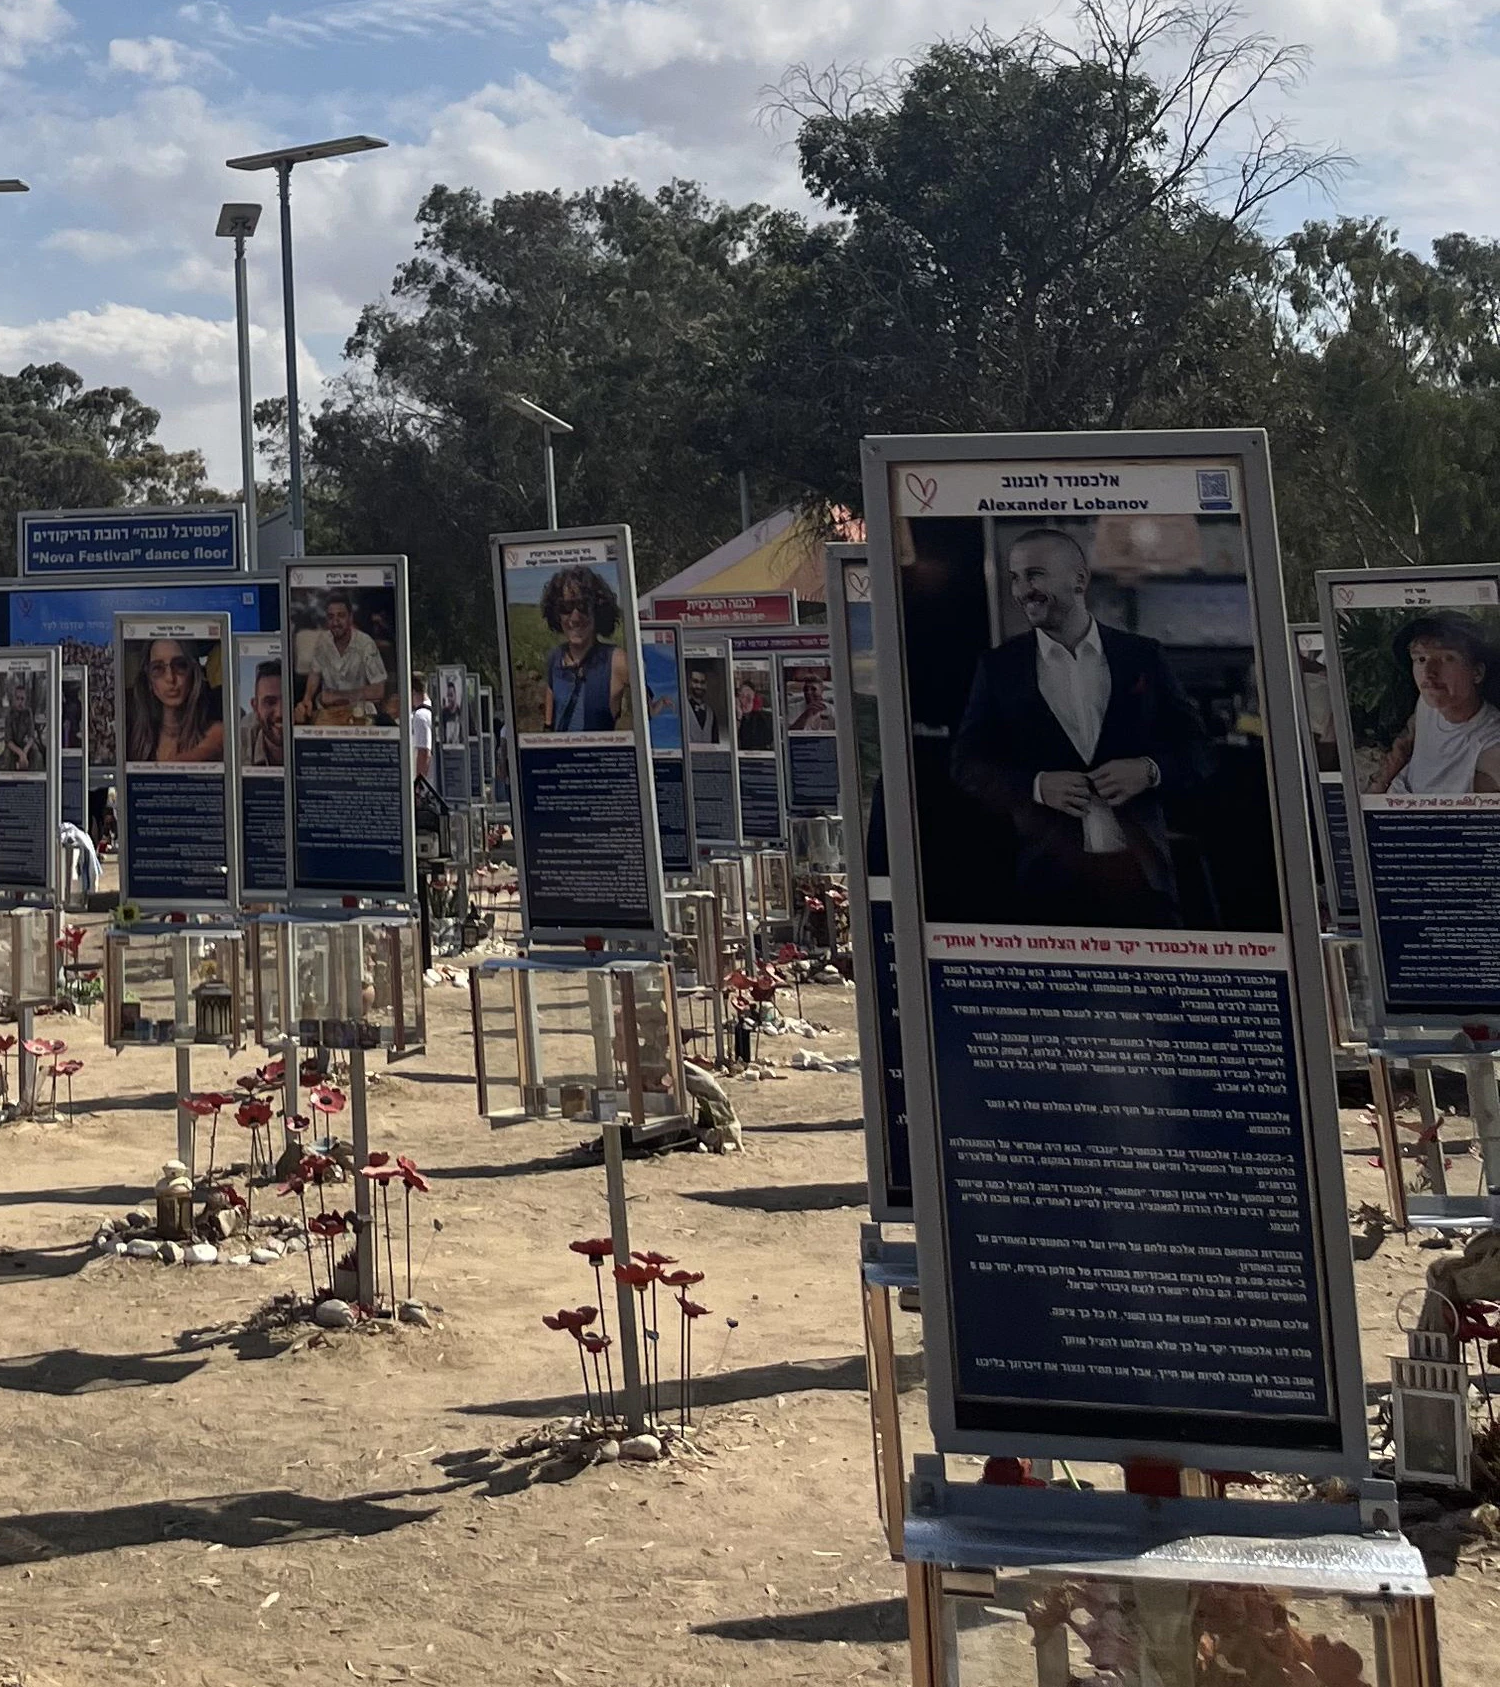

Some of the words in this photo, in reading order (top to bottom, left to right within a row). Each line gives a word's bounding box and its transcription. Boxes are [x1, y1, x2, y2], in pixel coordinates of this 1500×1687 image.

[1001, 473, 1049, 489] לובנוב
[1054, 473, 1121, 488] אלכסנדר
[977, 498, 1068, 512] Alexander
[1073, 497, 1150, 511] Lobanov
[33, 530, 91, 545] הריקודים
[94, 528, 130, 542] רחבת
[145, 547, 190, 561] dance
[193, 546, 229, 560] floor
[728, 597, 756, 610] הבמה
[679, 612, 701, 624] The
[703, 612, 730, 623] Main
[732, 611, 766, 623] Stage
[979, 934, 1022, 950] להציל
[1026, 937, 1076, 951] הצלחנו
[1080, 938, 1111, 952] שלא
[1115, 939, 1140, 956] יקר
[1145, 940, 1209, 955] אלכסנדר
[1213, 941, 1233, 956] לנו
